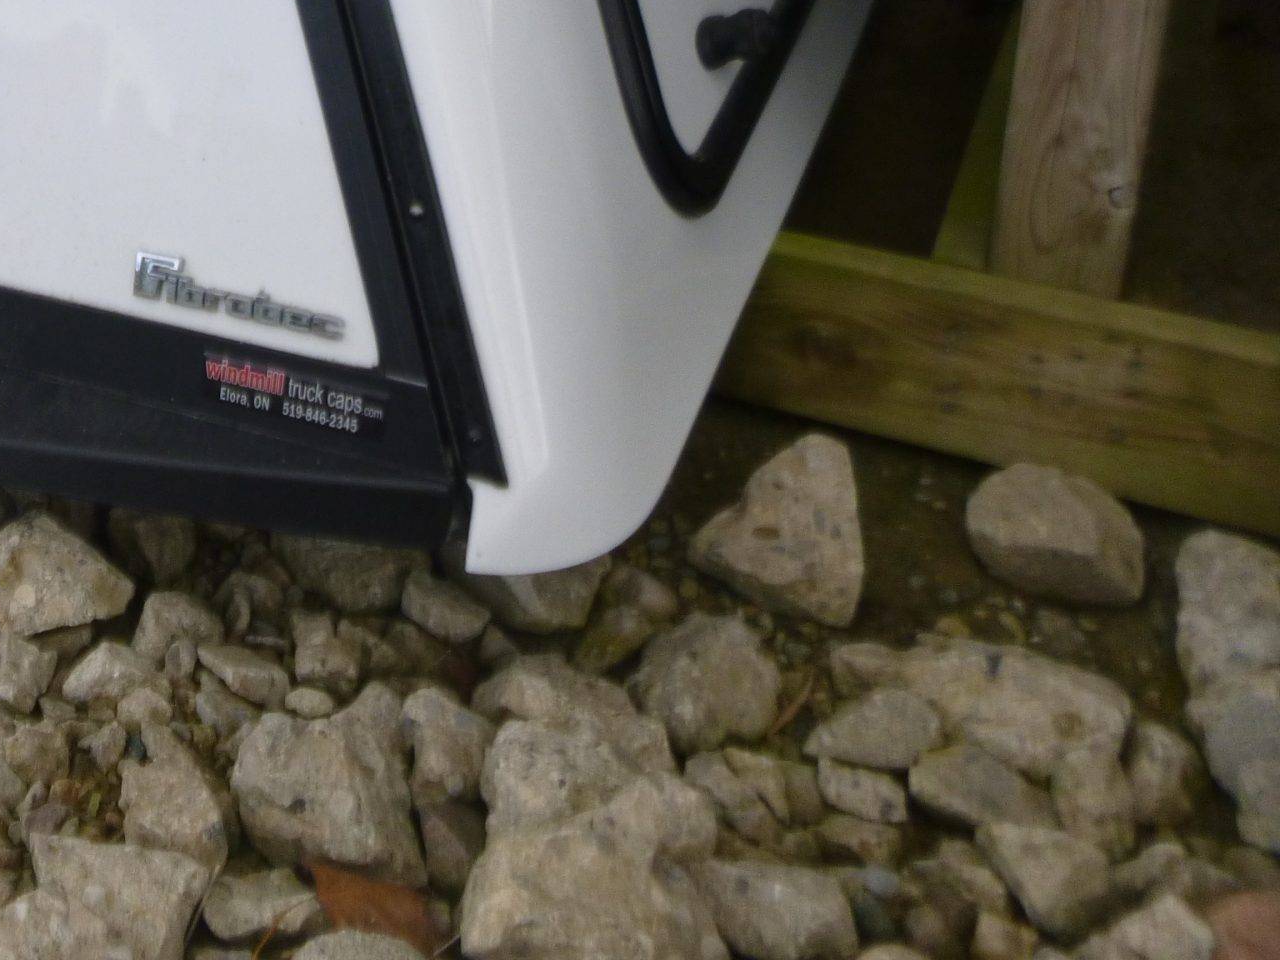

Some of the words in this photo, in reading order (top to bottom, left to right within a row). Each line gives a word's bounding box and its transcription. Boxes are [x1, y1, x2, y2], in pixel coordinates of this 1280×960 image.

[205, 359, 285, 396] windmill
[288, 379, 323, 405] truck
[254, 395, 270, 412] ON
[282, 402, 358, 434] 519-846-2345
